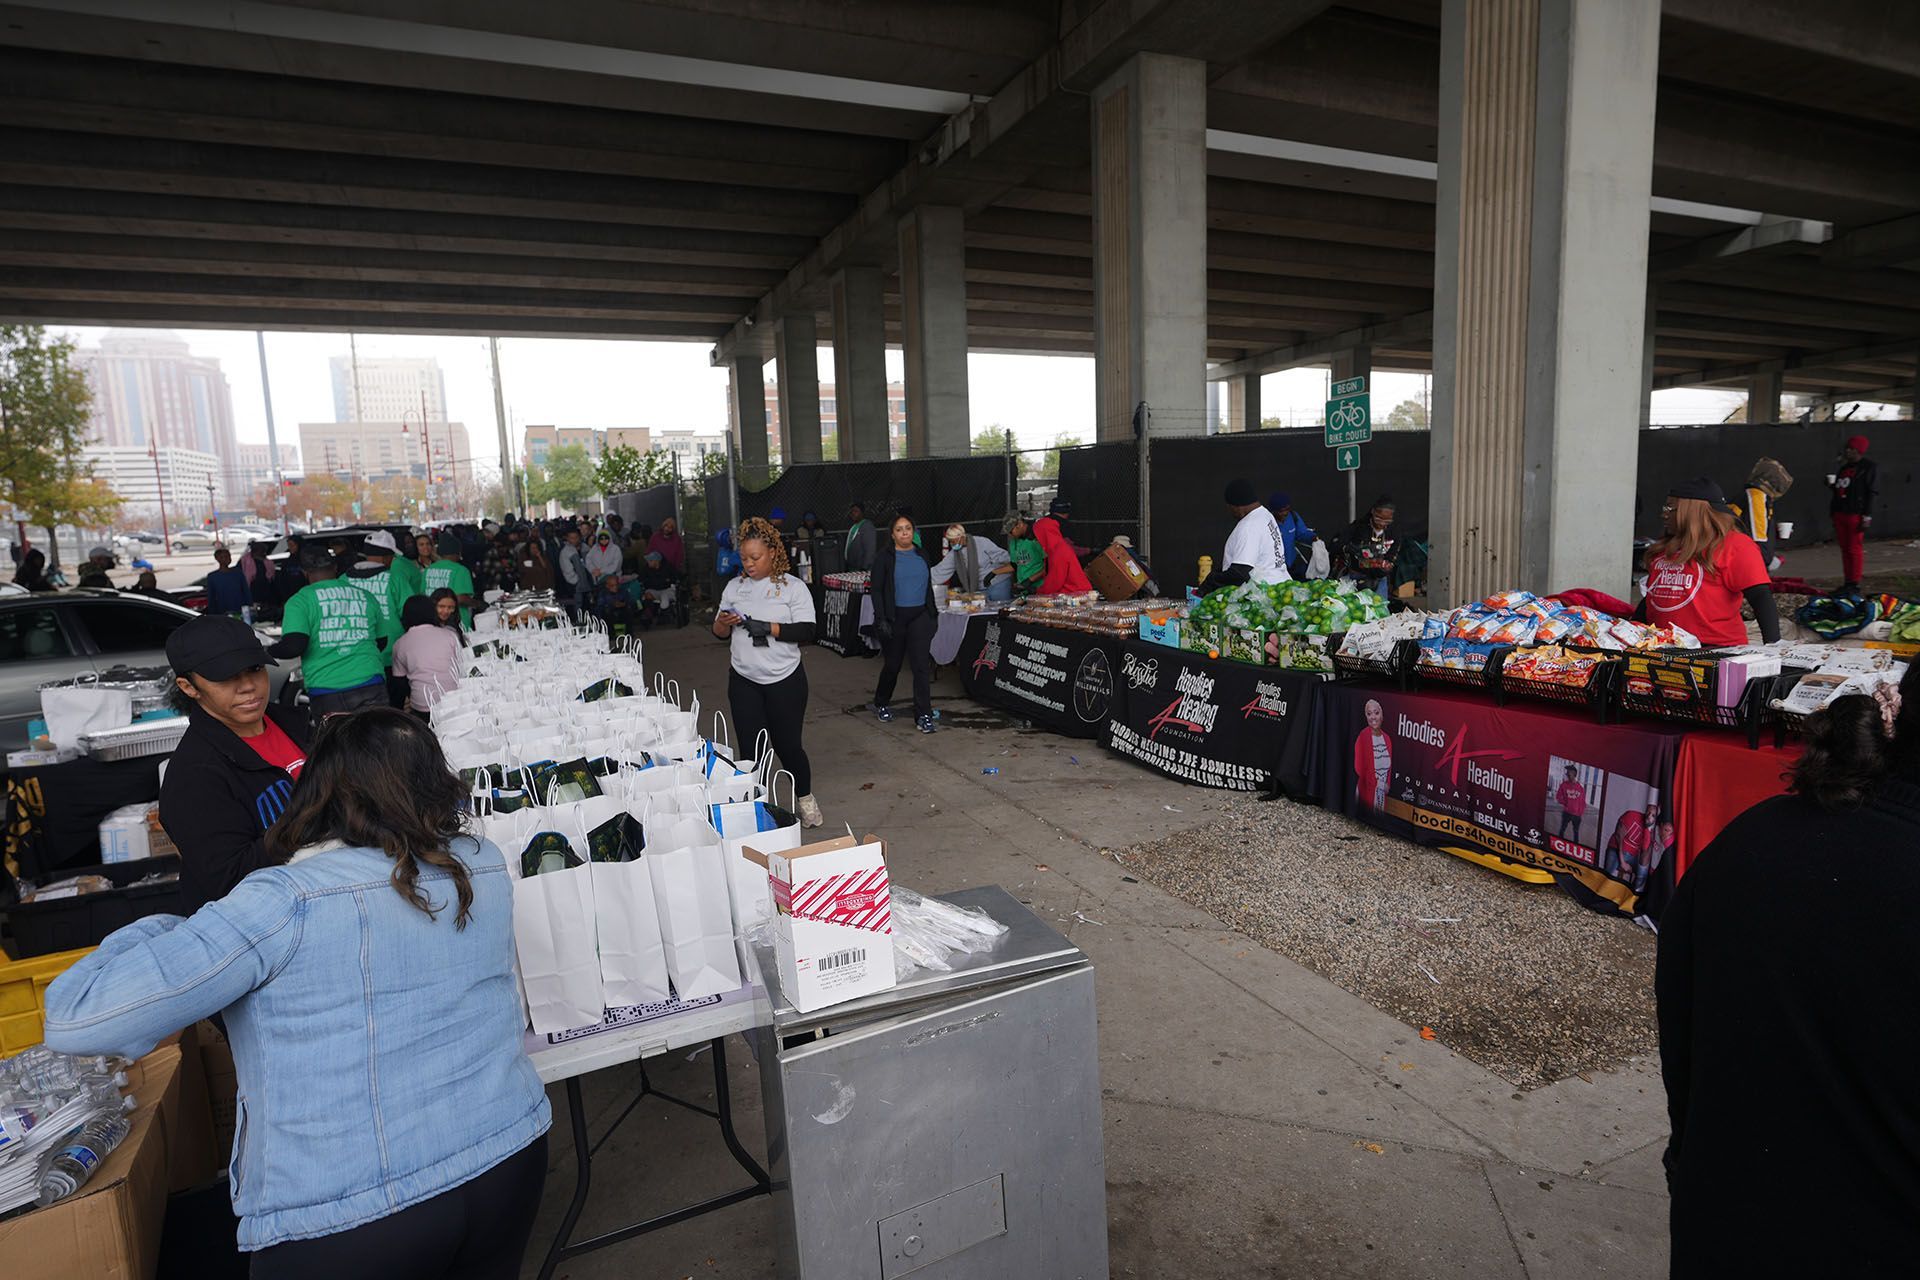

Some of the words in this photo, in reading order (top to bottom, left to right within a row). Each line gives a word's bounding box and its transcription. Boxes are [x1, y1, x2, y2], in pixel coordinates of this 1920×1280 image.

[1337, 381, 1358, 394] BEGIN
[1329, 433, 1343, 444] BIKE
[1346, 429, 1368, 441] ROUTE
[1661, 570, 1693, 589] Healing
[315, 586, 367, 601] DONATE
[319, 600, 367, 617] TODAY
[320, 617, 346, 630] HELP
[348, 617, 369, 629] THE
[319, 629, 369, 643] HOMELESS
[1014, 633, 1031, 647] HOPE
[1030, 638, 1043, 651] AND
[1175, 666, 1215, 699] Hoodies
[1256, 680, 1281, 698] Hoodies
[1176, 692, 1219, 733] Healing
[1259, 694, 1287, 716] Healing
[1160, 725, 1204, 744] FOUNDATION
[1397, 712, 1445, 748] Hoodies
[1178, 750, 1199, 767] THE
[1467, 759, 1514, 800] Healing
[1395, 772, 1507, 816] FOUNDATION
[1411, 807, 1583, 877] hoodies4healing.com
[1553, 839, 1594, 863] GLUE
